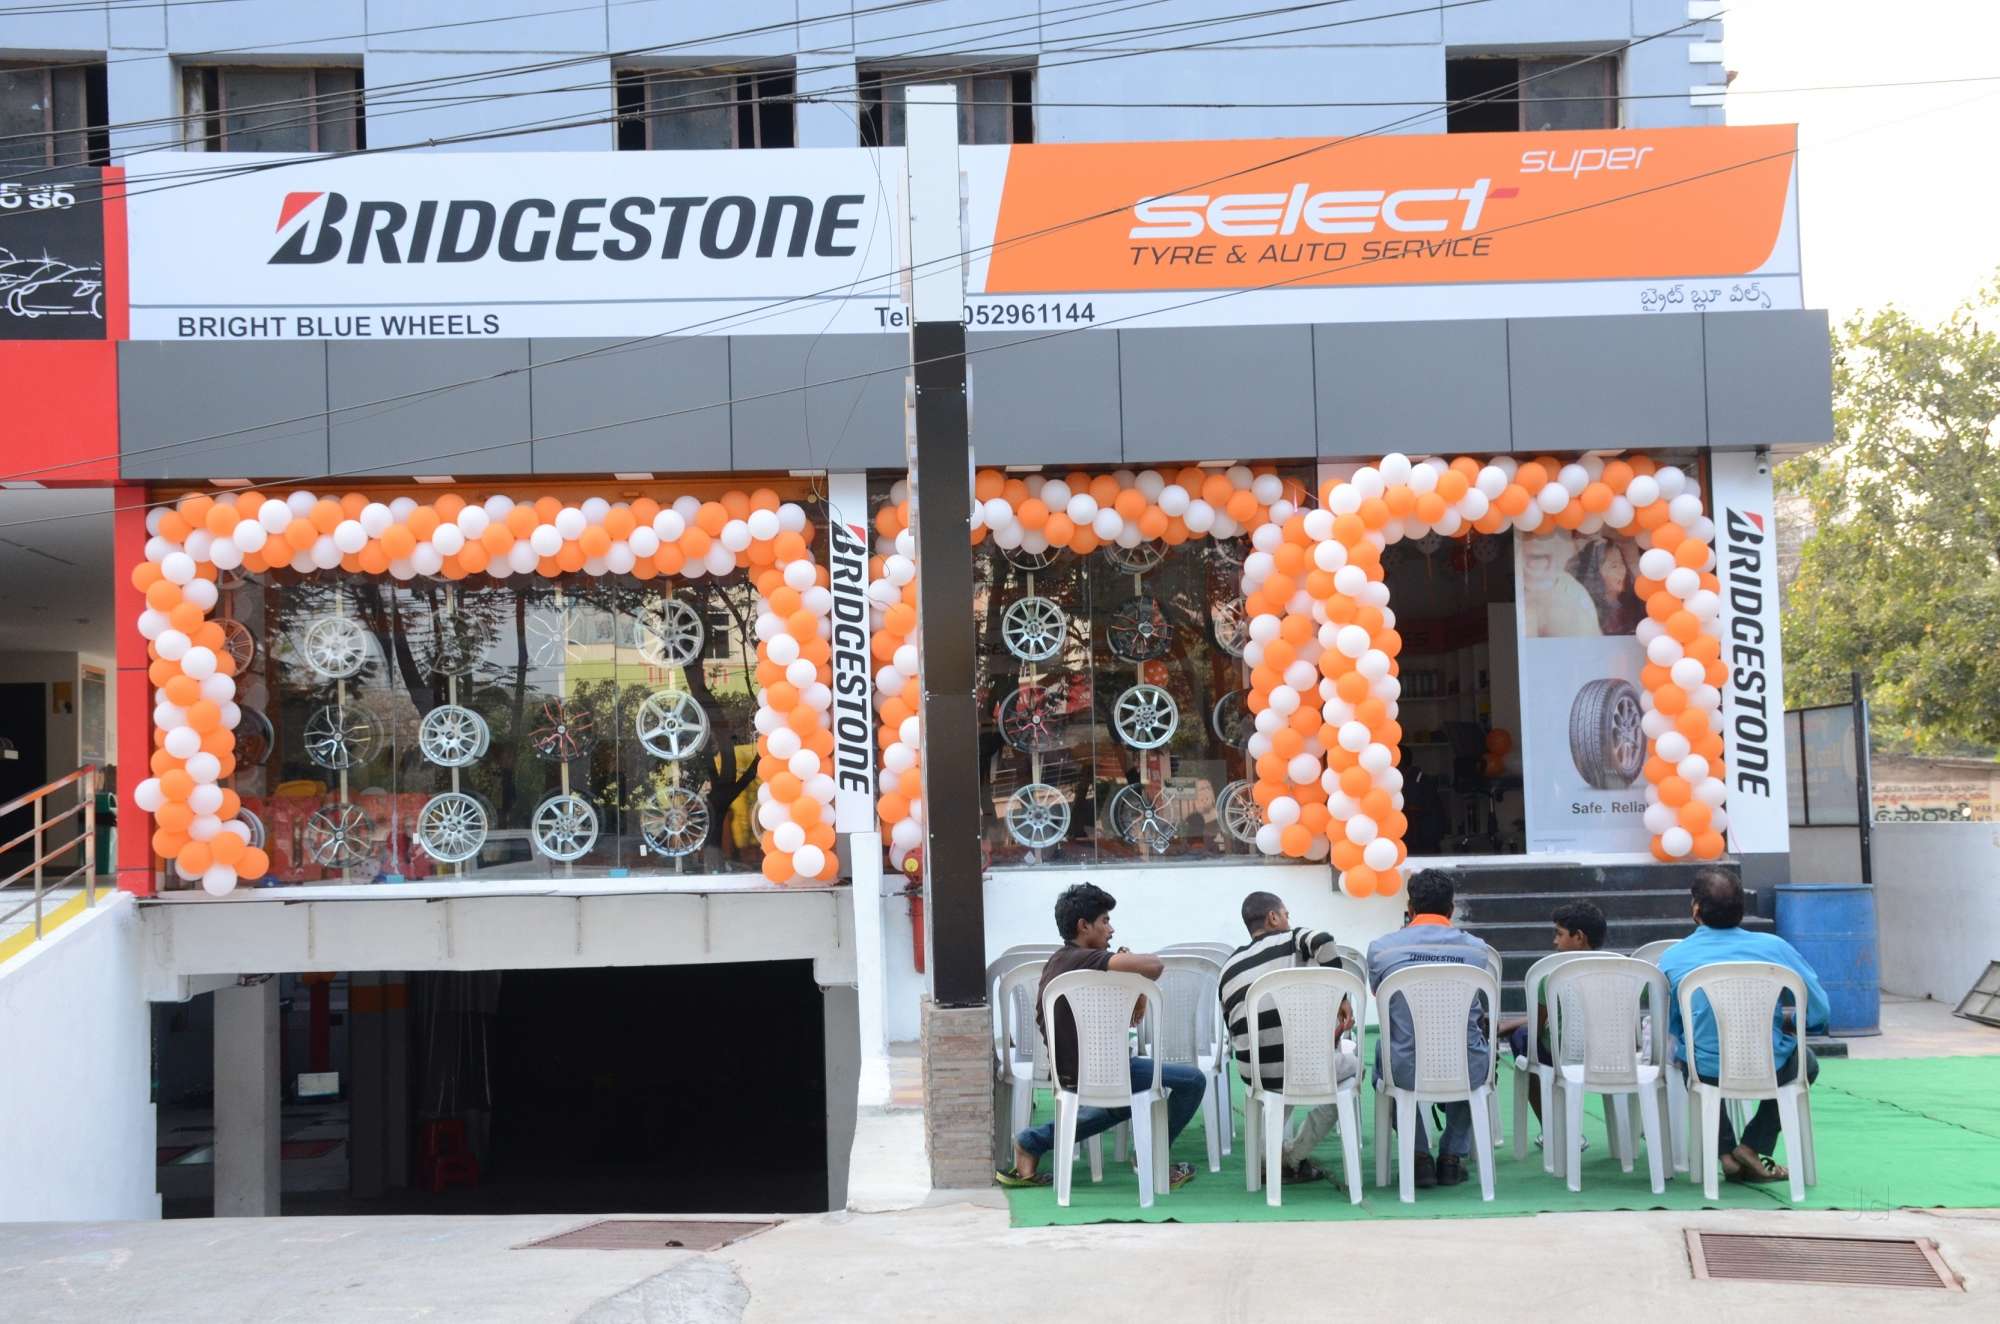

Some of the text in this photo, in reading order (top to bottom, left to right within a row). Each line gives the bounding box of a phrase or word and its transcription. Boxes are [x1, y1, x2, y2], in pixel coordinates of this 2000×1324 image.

[1519, 146, 1654, 179] super
[267, 191, 866, 265] BRIDGESTONE
[1130, 236, 1493, 266] TYRE & AUTO SERVICE
[178, 314, 501, 338] BRIGHT BLUE WHEELS
[965, 302, 1096, 325] 052961144
[831, 520, 870, 795] BRIDGESTONE
[1726, 507, 1770, 798] BRIDGESTONE
[1571, 801, 1650, 814] Safe. Relia
